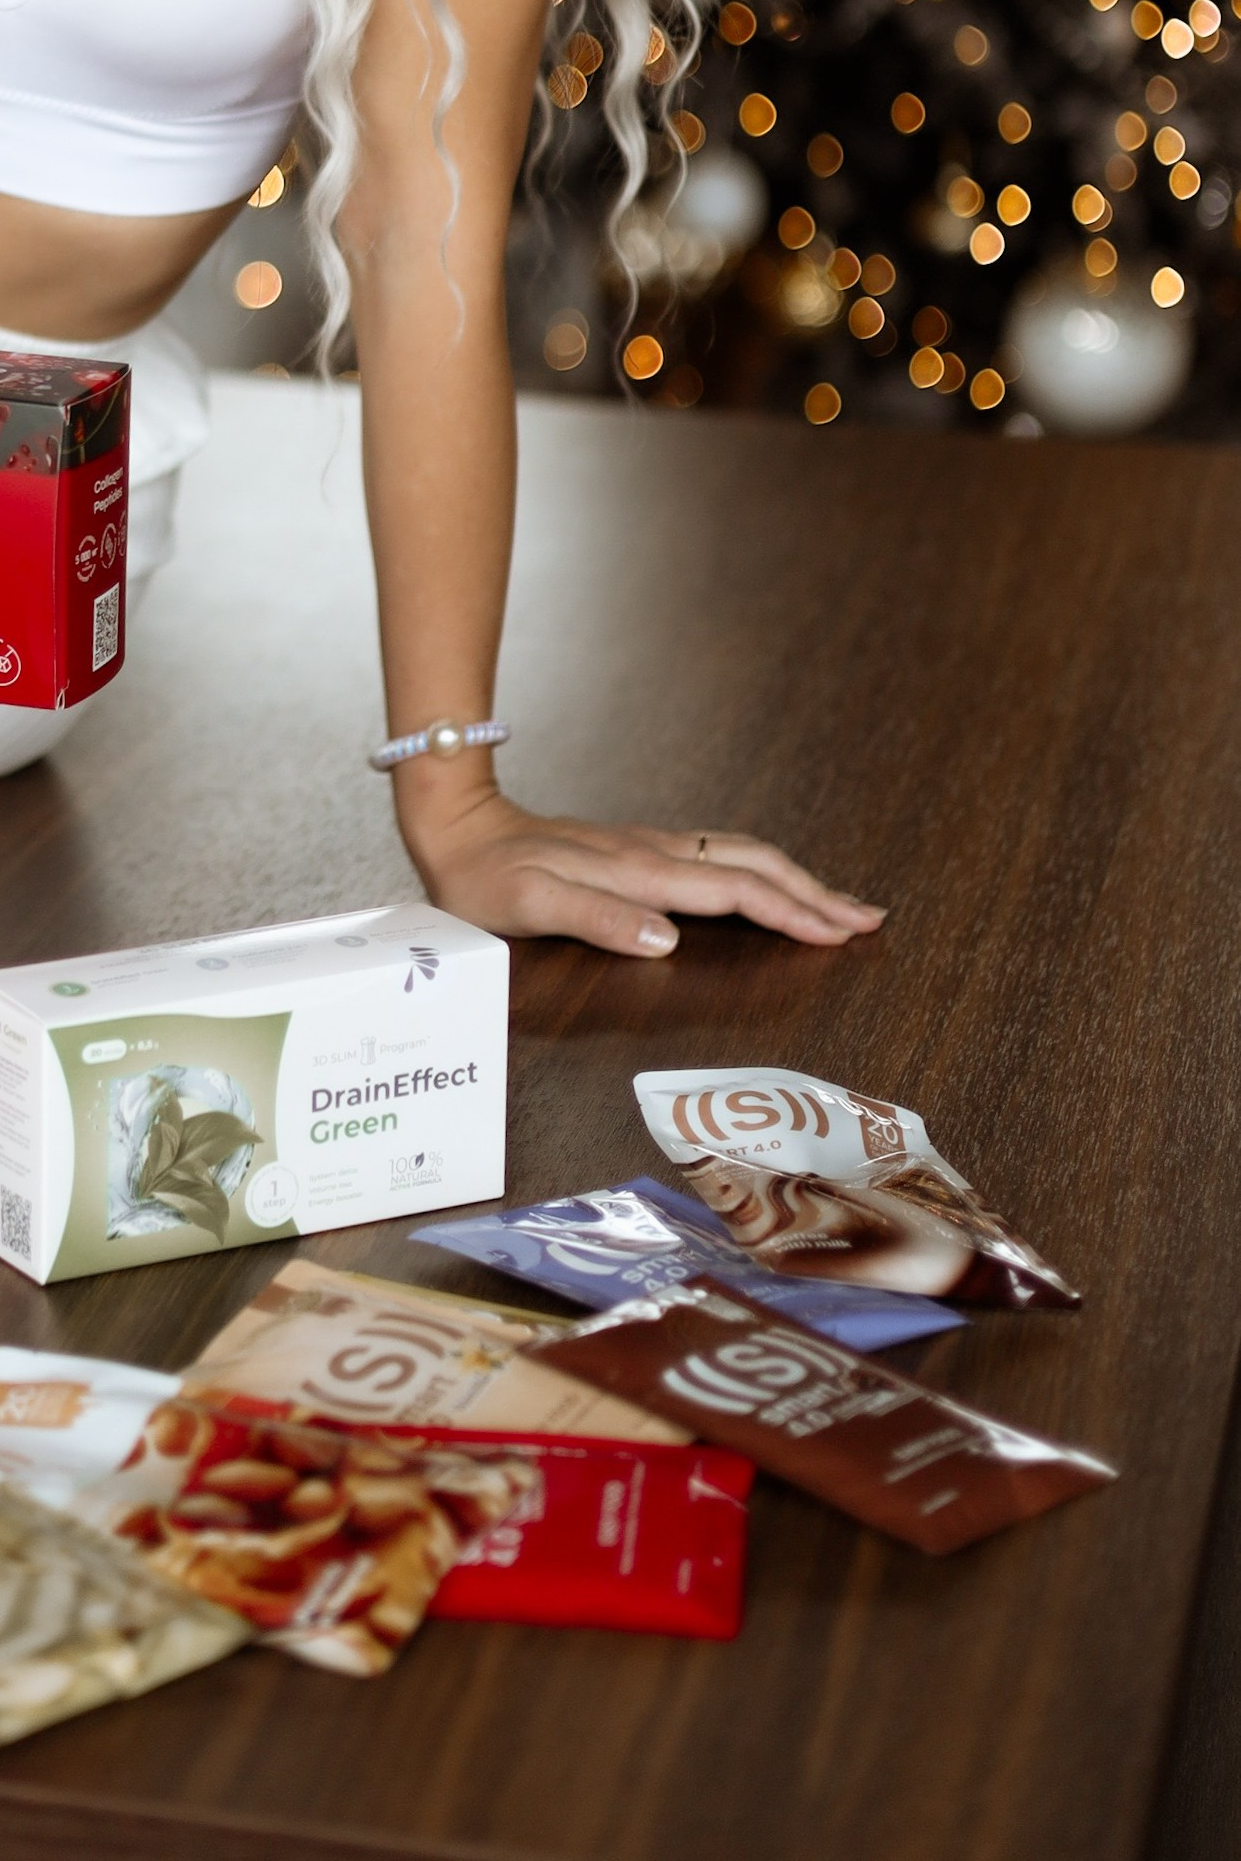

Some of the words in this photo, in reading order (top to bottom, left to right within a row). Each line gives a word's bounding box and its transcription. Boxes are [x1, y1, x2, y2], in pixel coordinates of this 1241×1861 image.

[311, 1054, 328, 1068] 3D
[330, 1049, 357, 1065] SLIM
[311, 1062, 478, 1113] DrainEffect
[309, 1112, 398, 1145] Green
[753, 1140, 782, 1154] 4.0
[389, 1168, 441, 1185] NATURAL
[412, 1177, 443, 1188] FORMULA
[271, 1180, 278, 1197] 1
[263, 1198, 286, 1209] step
